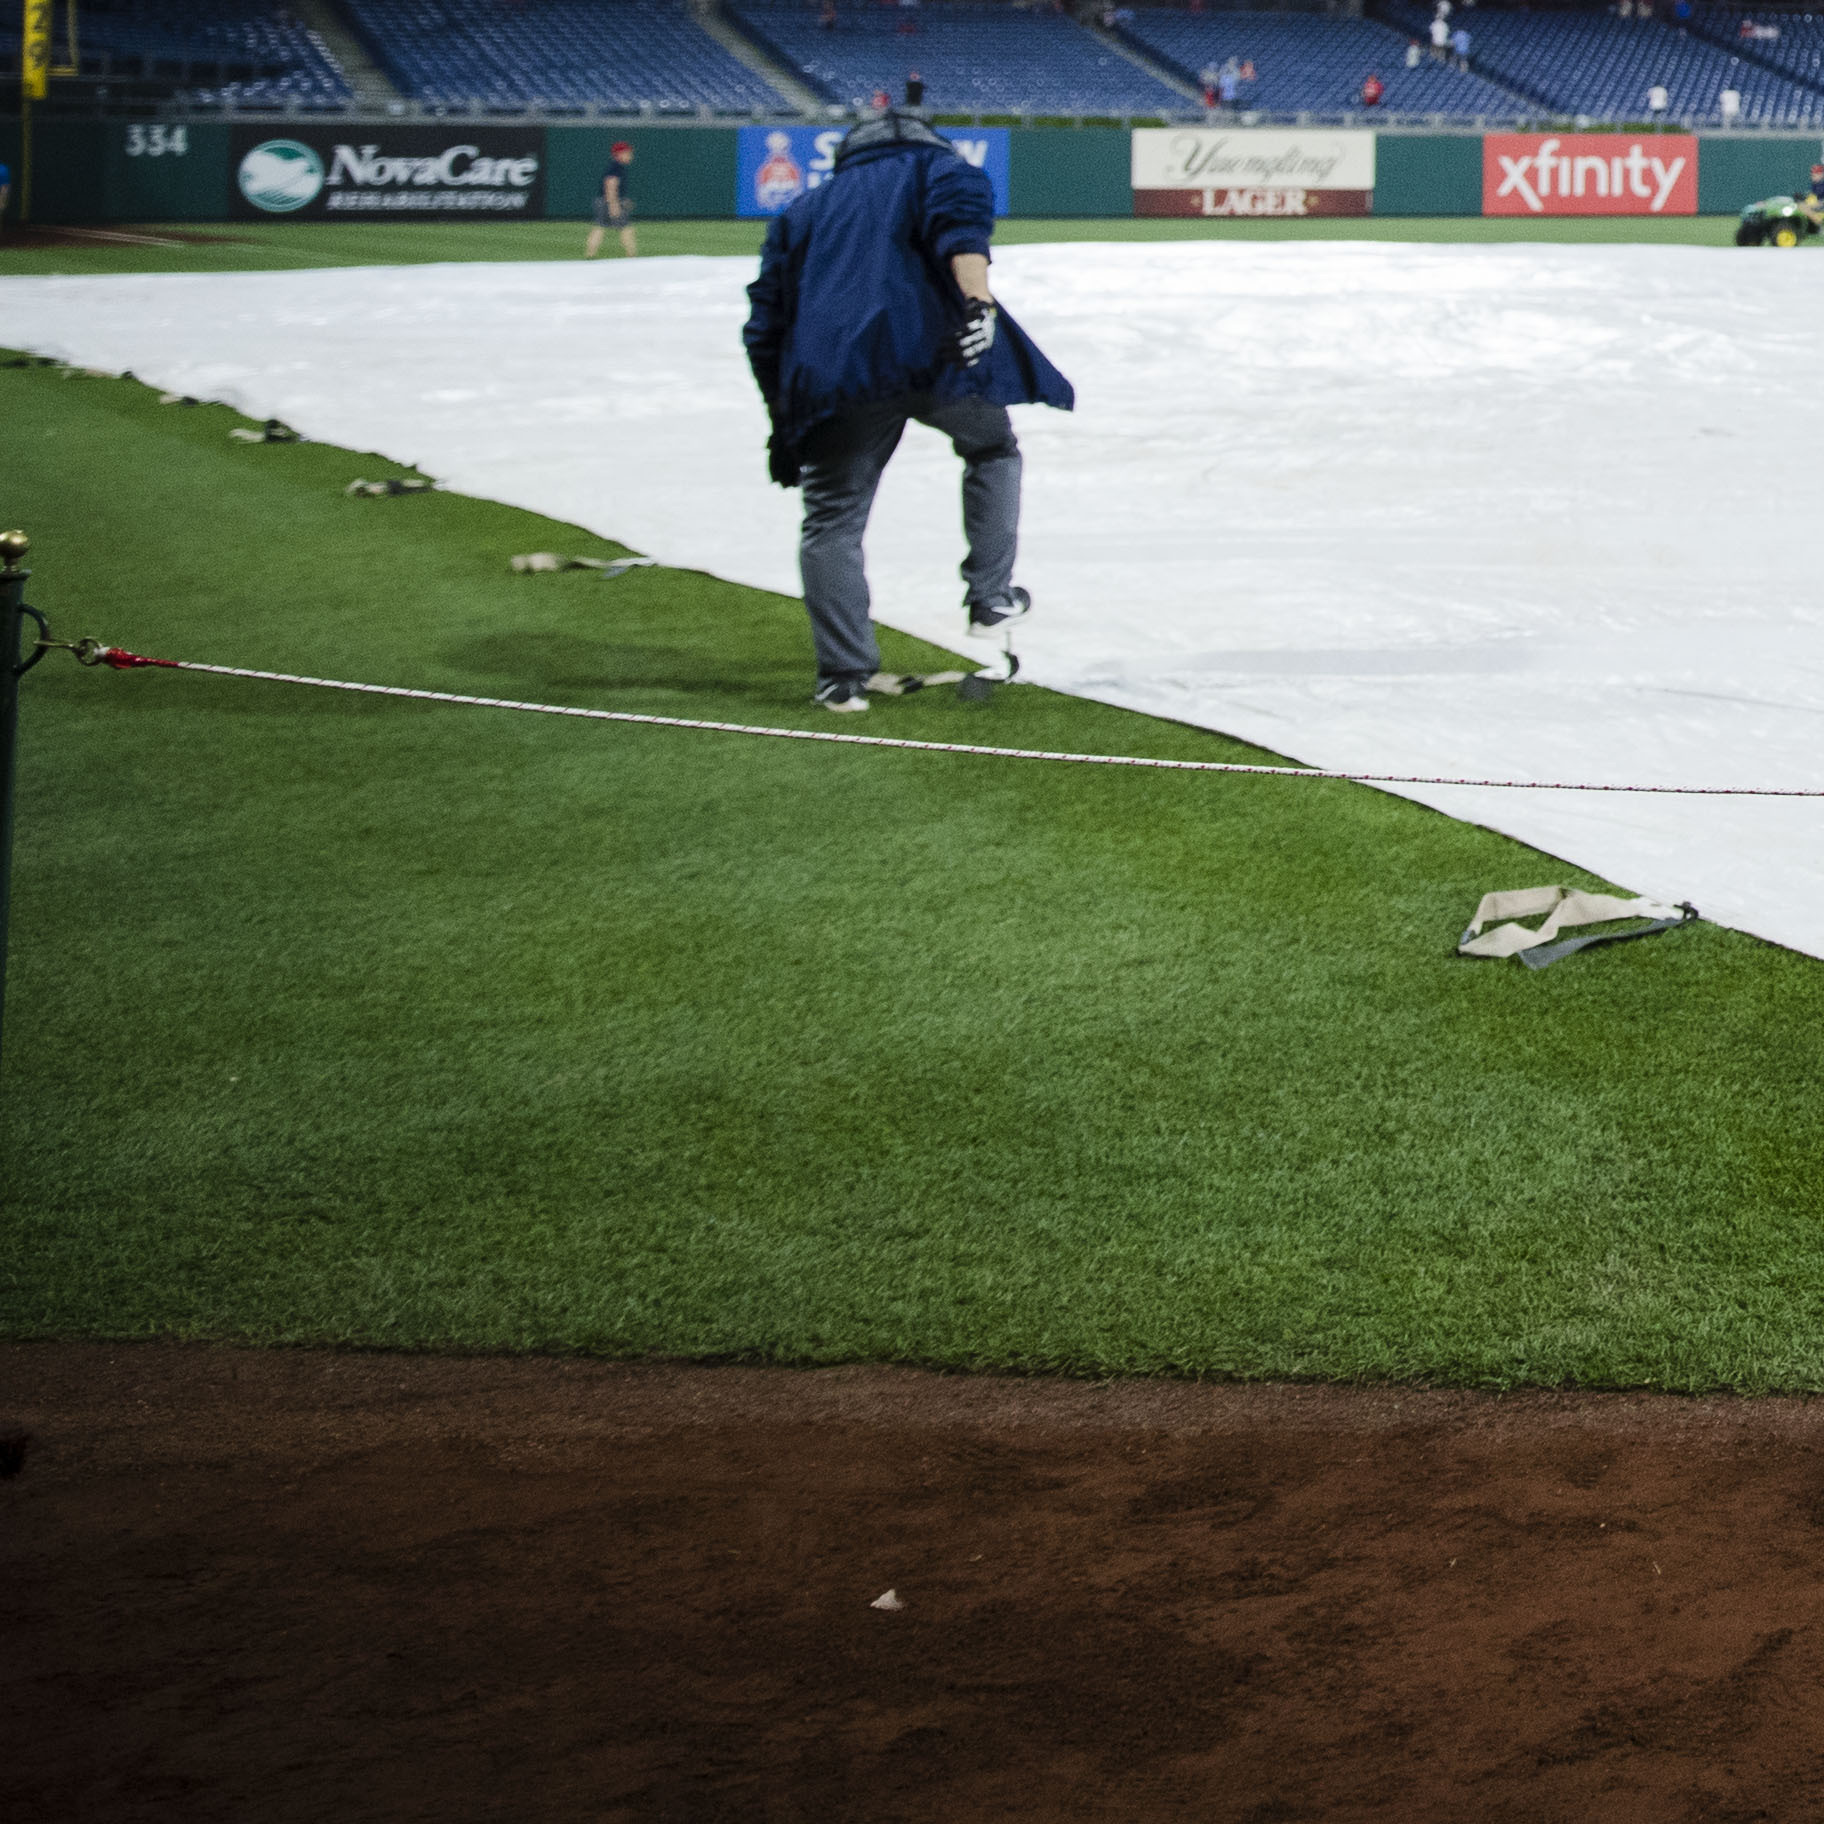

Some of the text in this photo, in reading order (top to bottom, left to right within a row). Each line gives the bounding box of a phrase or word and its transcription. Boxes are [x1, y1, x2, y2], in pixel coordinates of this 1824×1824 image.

[126, 125, 188, 157] 334
[325, 144, 539, 187] NovaCare
[1496, 138, 1686, 212] xfinity
[1201, 188, 1309, 216] LAGER
